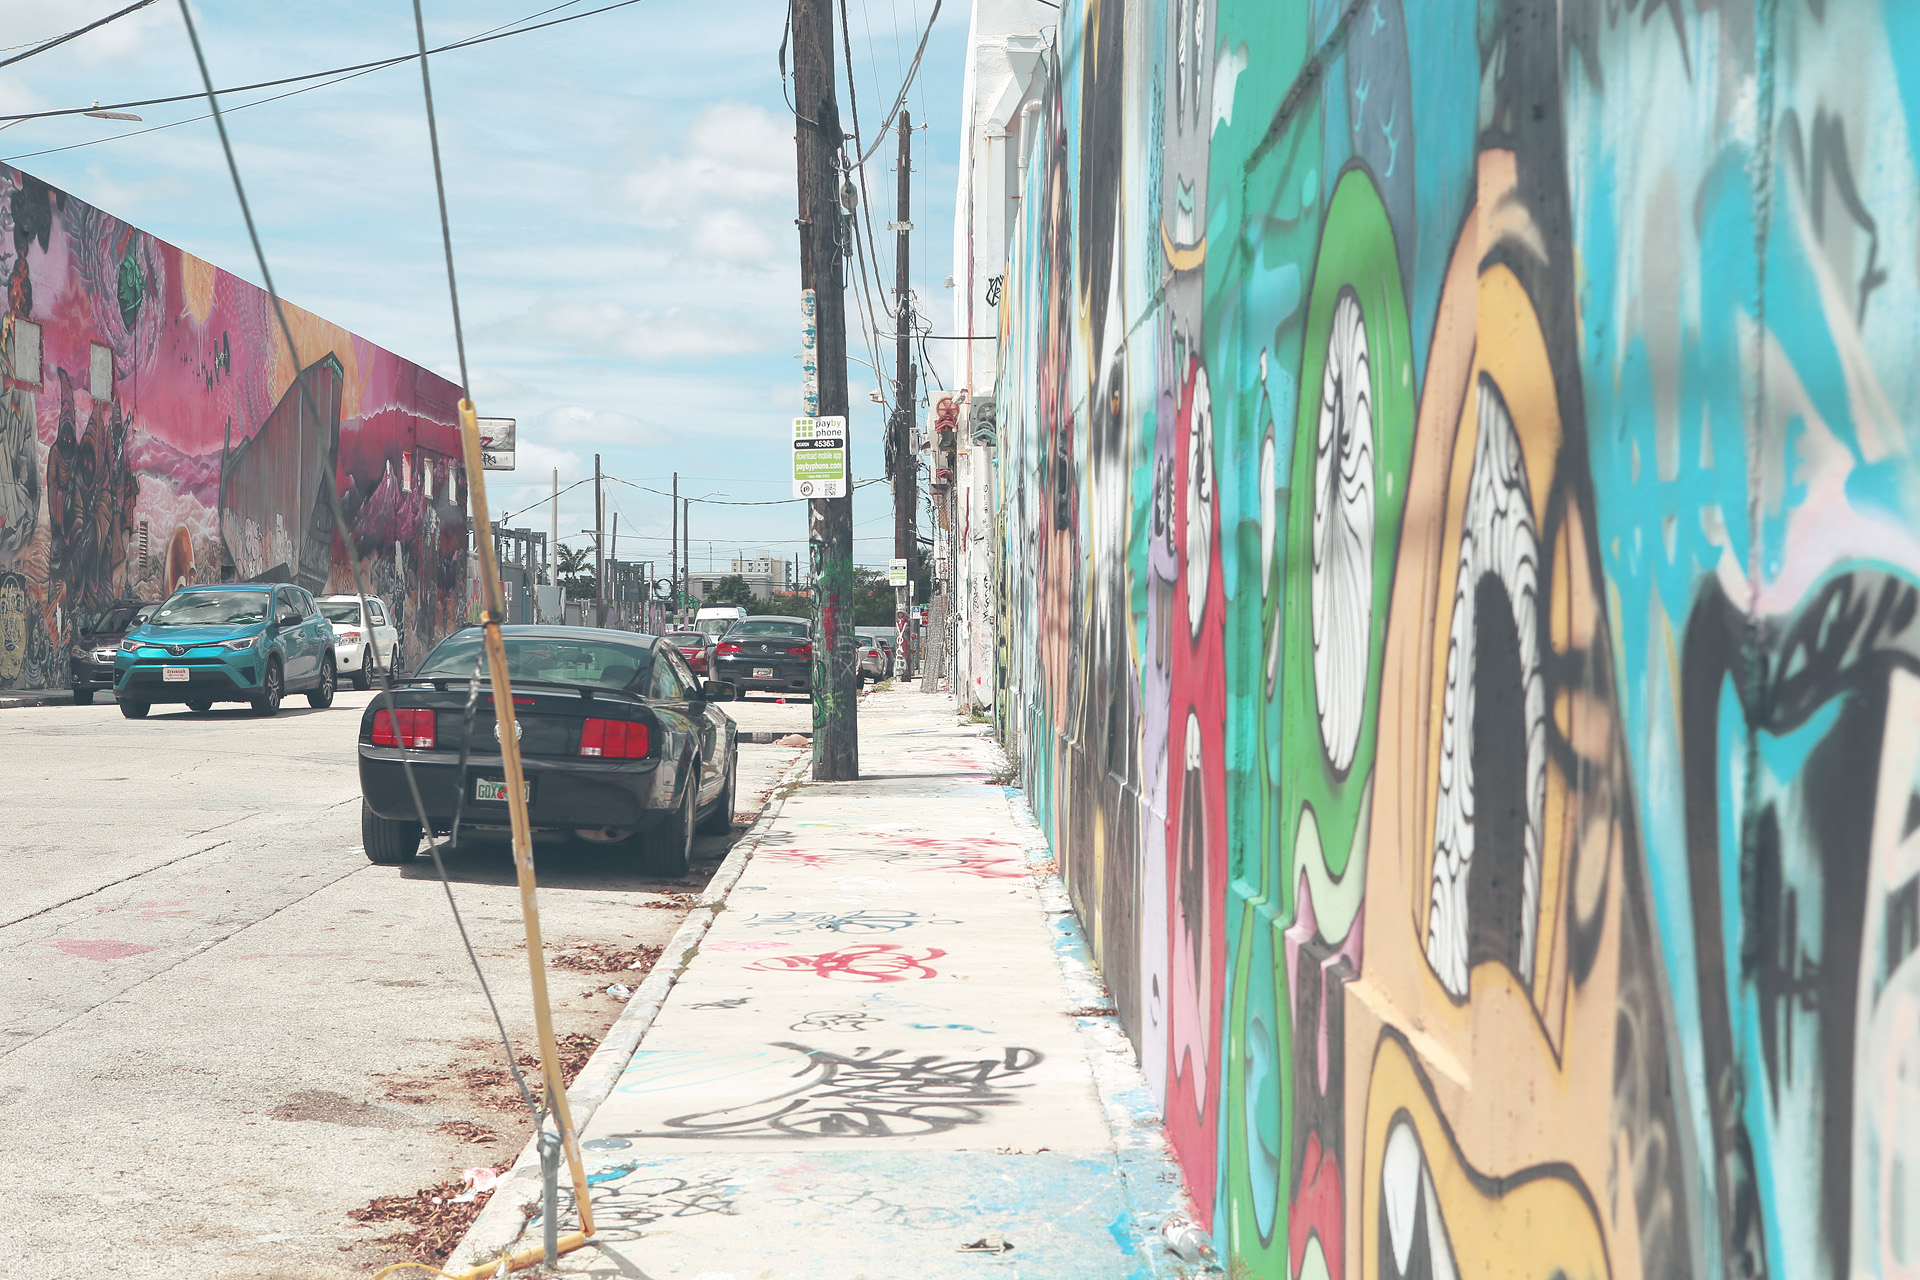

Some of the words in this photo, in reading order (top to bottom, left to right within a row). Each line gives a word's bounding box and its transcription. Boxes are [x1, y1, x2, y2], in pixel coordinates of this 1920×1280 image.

[815, 420, 841, 428] payby
[816, 429, 842, 438] phone
[796, 452, 817, 460] download
[833, 452, 842, 460] app
[796, 462, 842, 471] paybyphone.com
